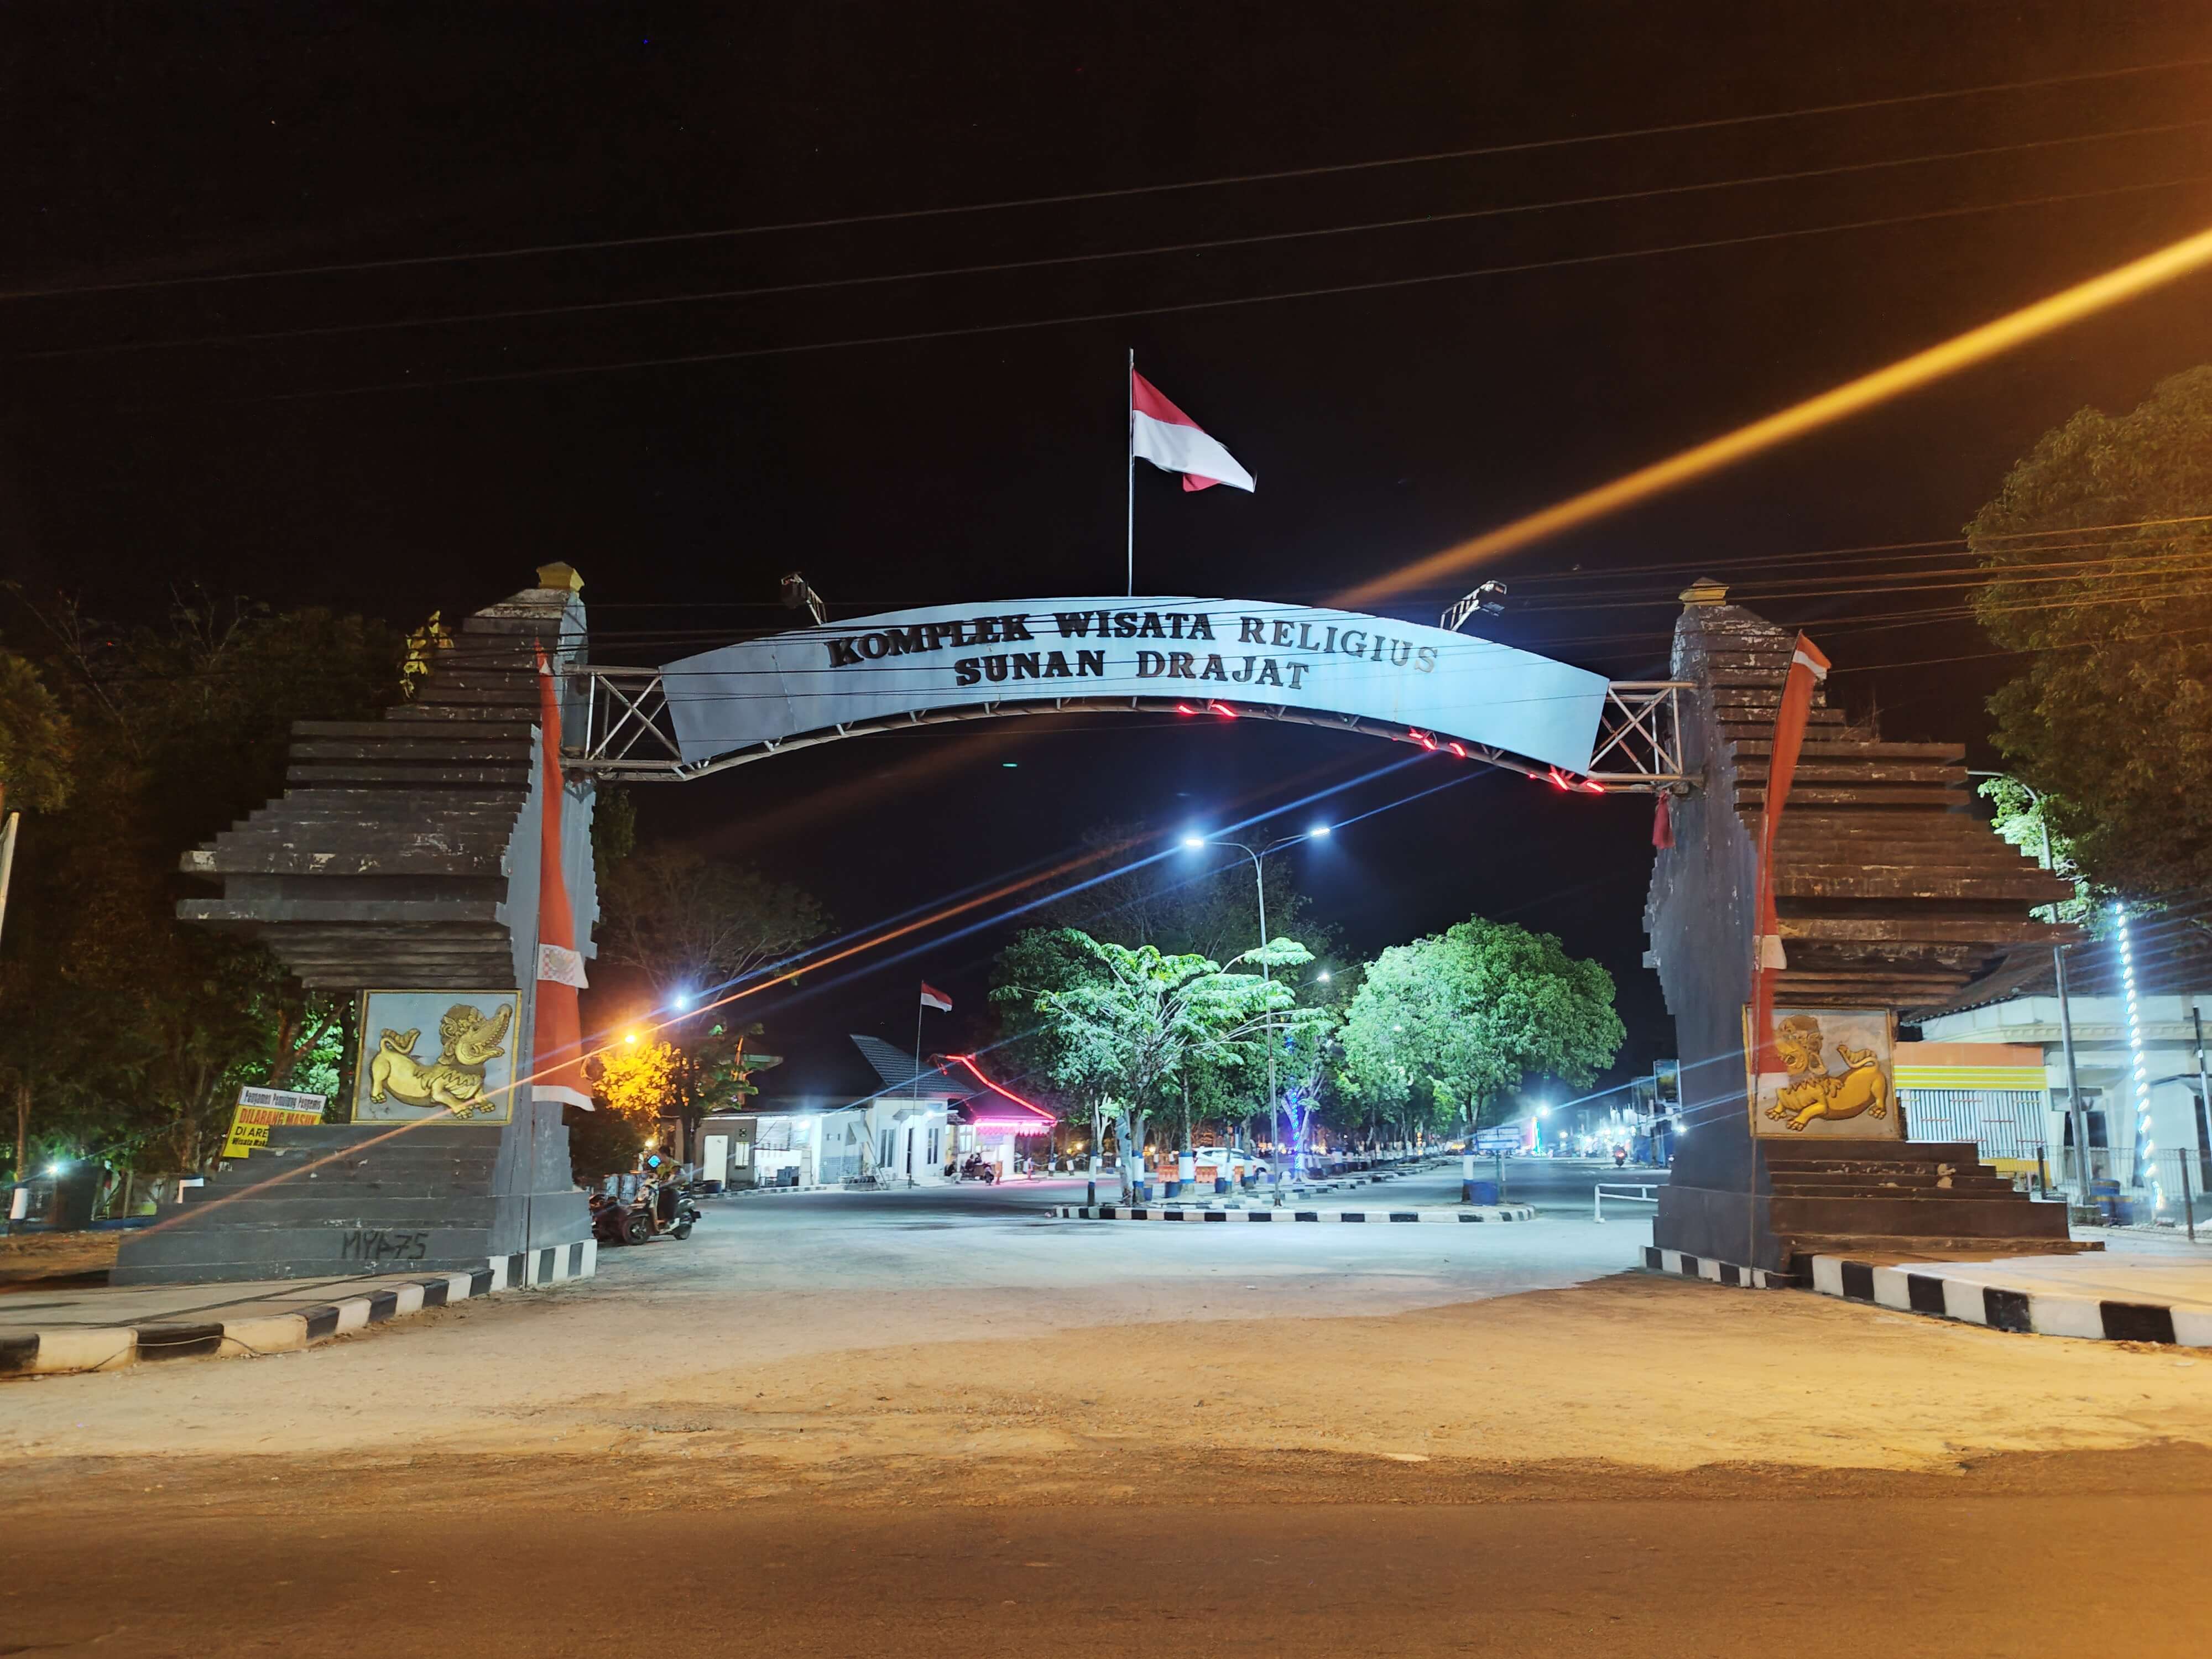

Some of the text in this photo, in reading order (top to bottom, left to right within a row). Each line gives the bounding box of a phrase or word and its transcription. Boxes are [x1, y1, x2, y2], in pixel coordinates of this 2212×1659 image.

[824, 612, 1438, 672] KOMPLEK WISATA RELIGIUS
[954, 650, 1309, 690] SUNAN DRAJAT
[238, 1108, 317, 1125] DILARANG MASUK
[235, 1126, 270, 1138] DI ARE
[253, 1139, 268, 1147] Mak
